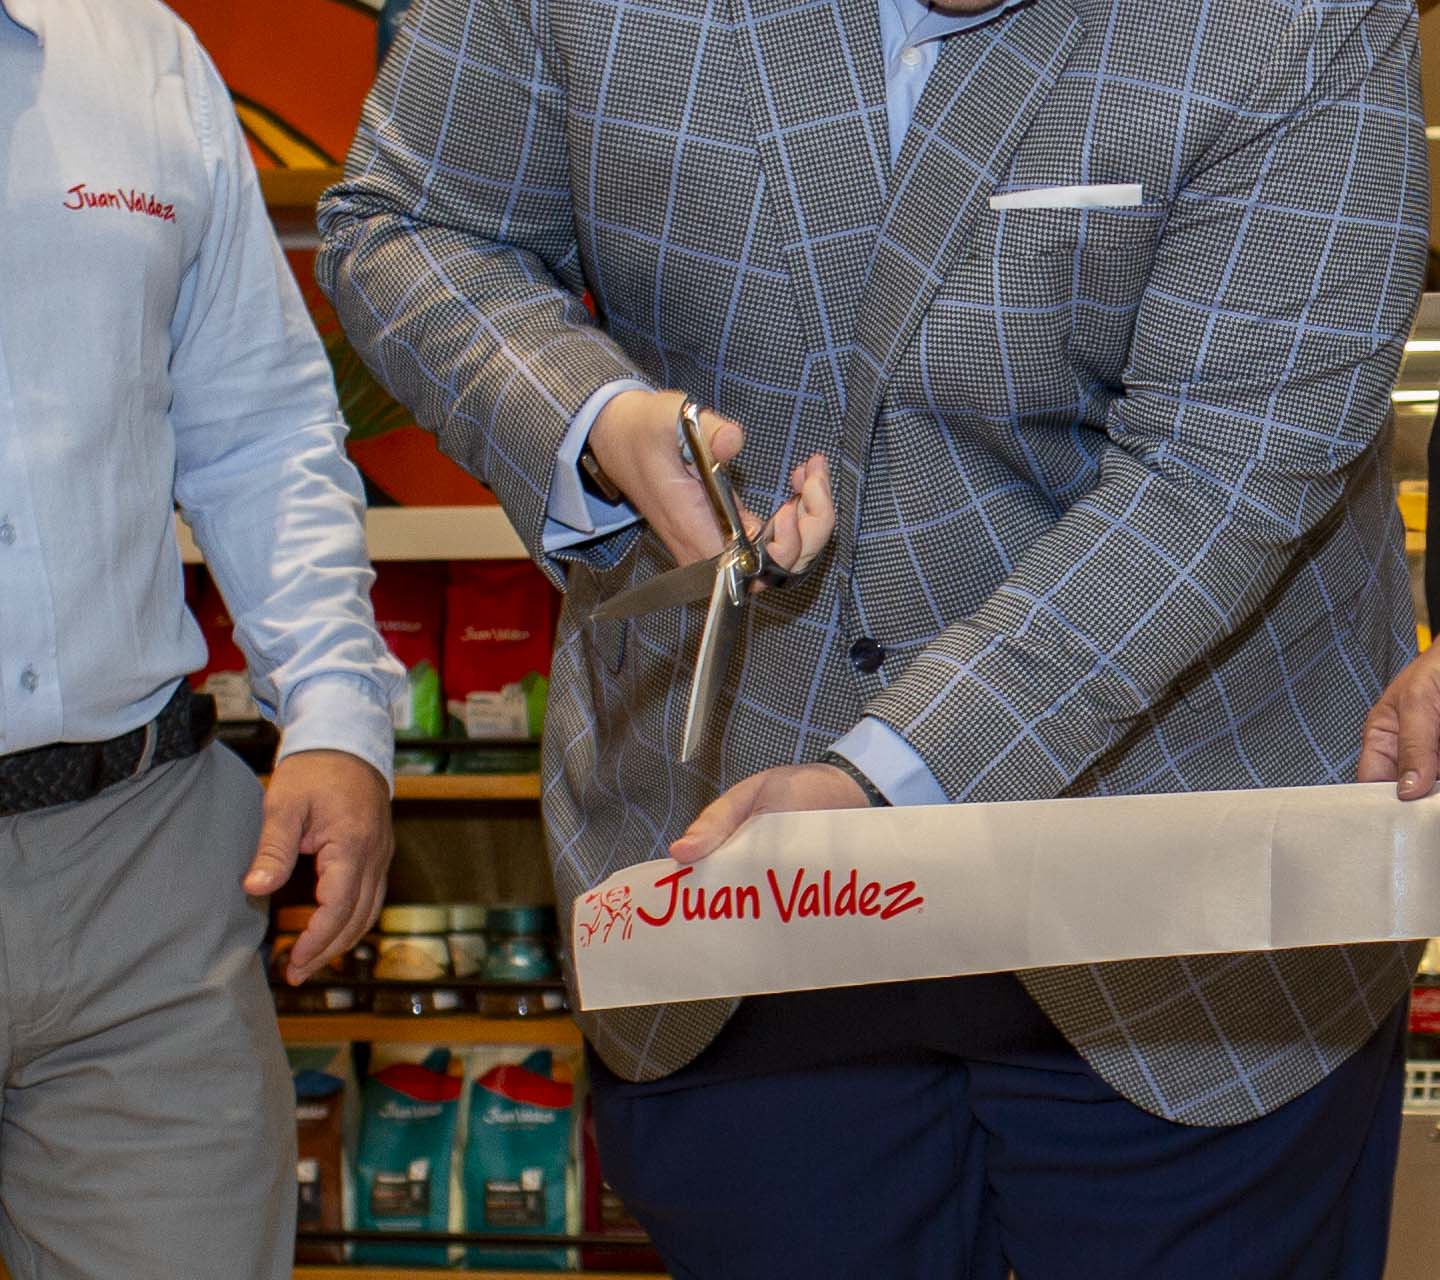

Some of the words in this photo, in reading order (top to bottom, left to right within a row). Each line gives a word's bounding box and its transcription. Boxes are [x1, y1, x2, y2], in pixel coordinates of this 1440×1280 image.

[63, 183, 120, 211] Juan
[117, 188, 176, 222] Valdez
[636, 866, 761, 928] Juan
[766, 867, 925, 924] Valdez
